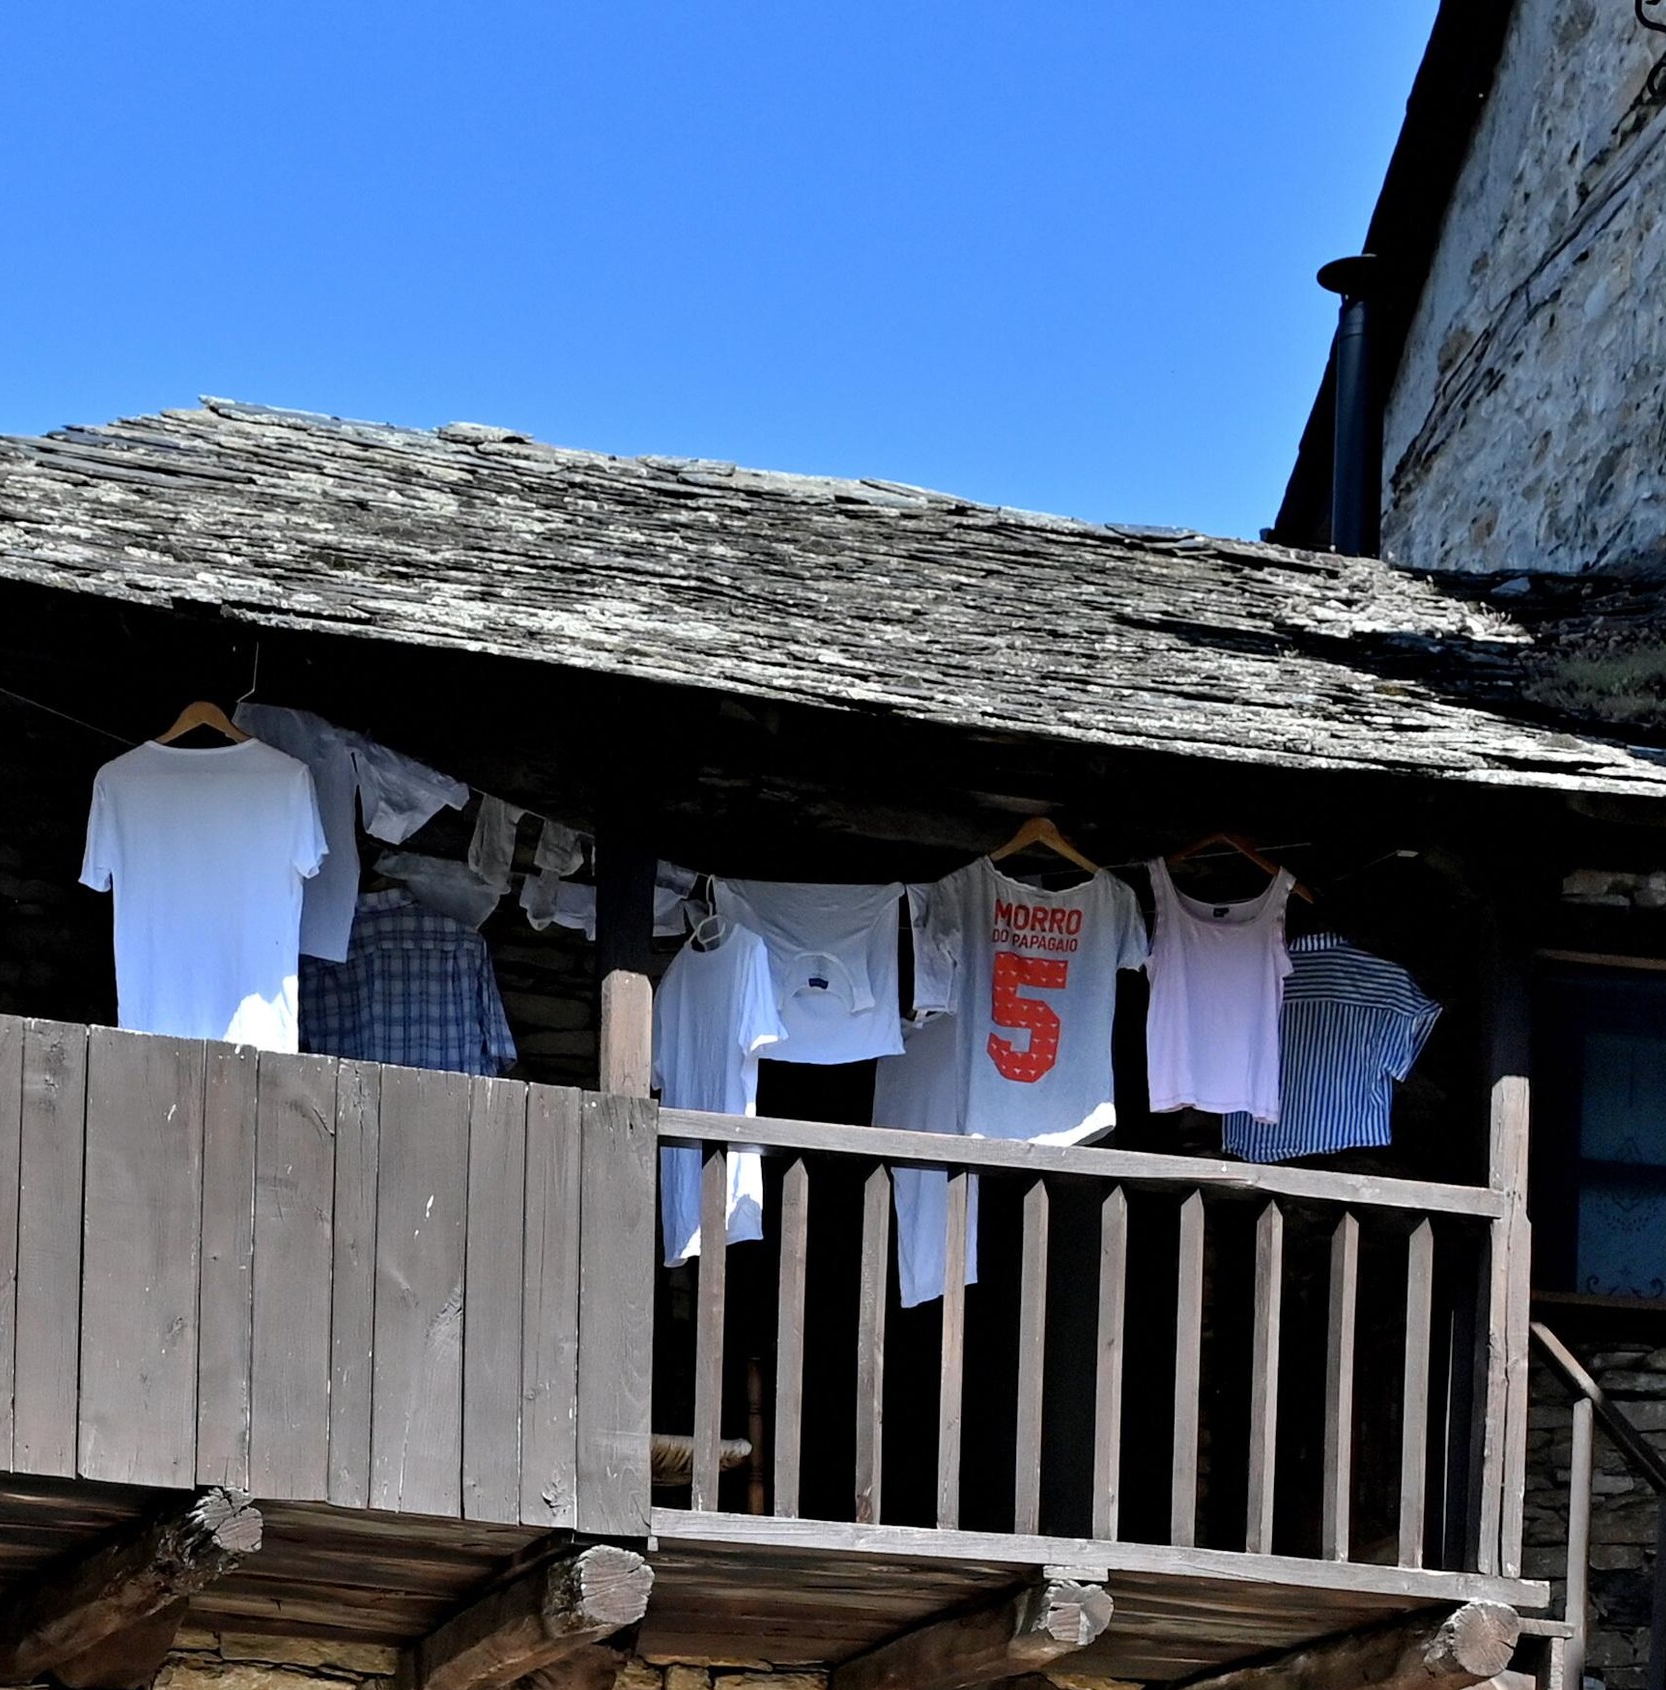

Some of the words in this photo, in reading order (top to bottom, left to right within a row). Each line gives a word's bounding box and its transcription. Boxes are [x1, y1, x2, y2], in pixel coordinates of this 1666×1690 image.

[994, 898, 1082, 937] MORRO
[992, 928, 1009, 944] DO
[1012, 933, 1078, 953] PAPAGAIO
[987, 950, 1069, 1083] 5
